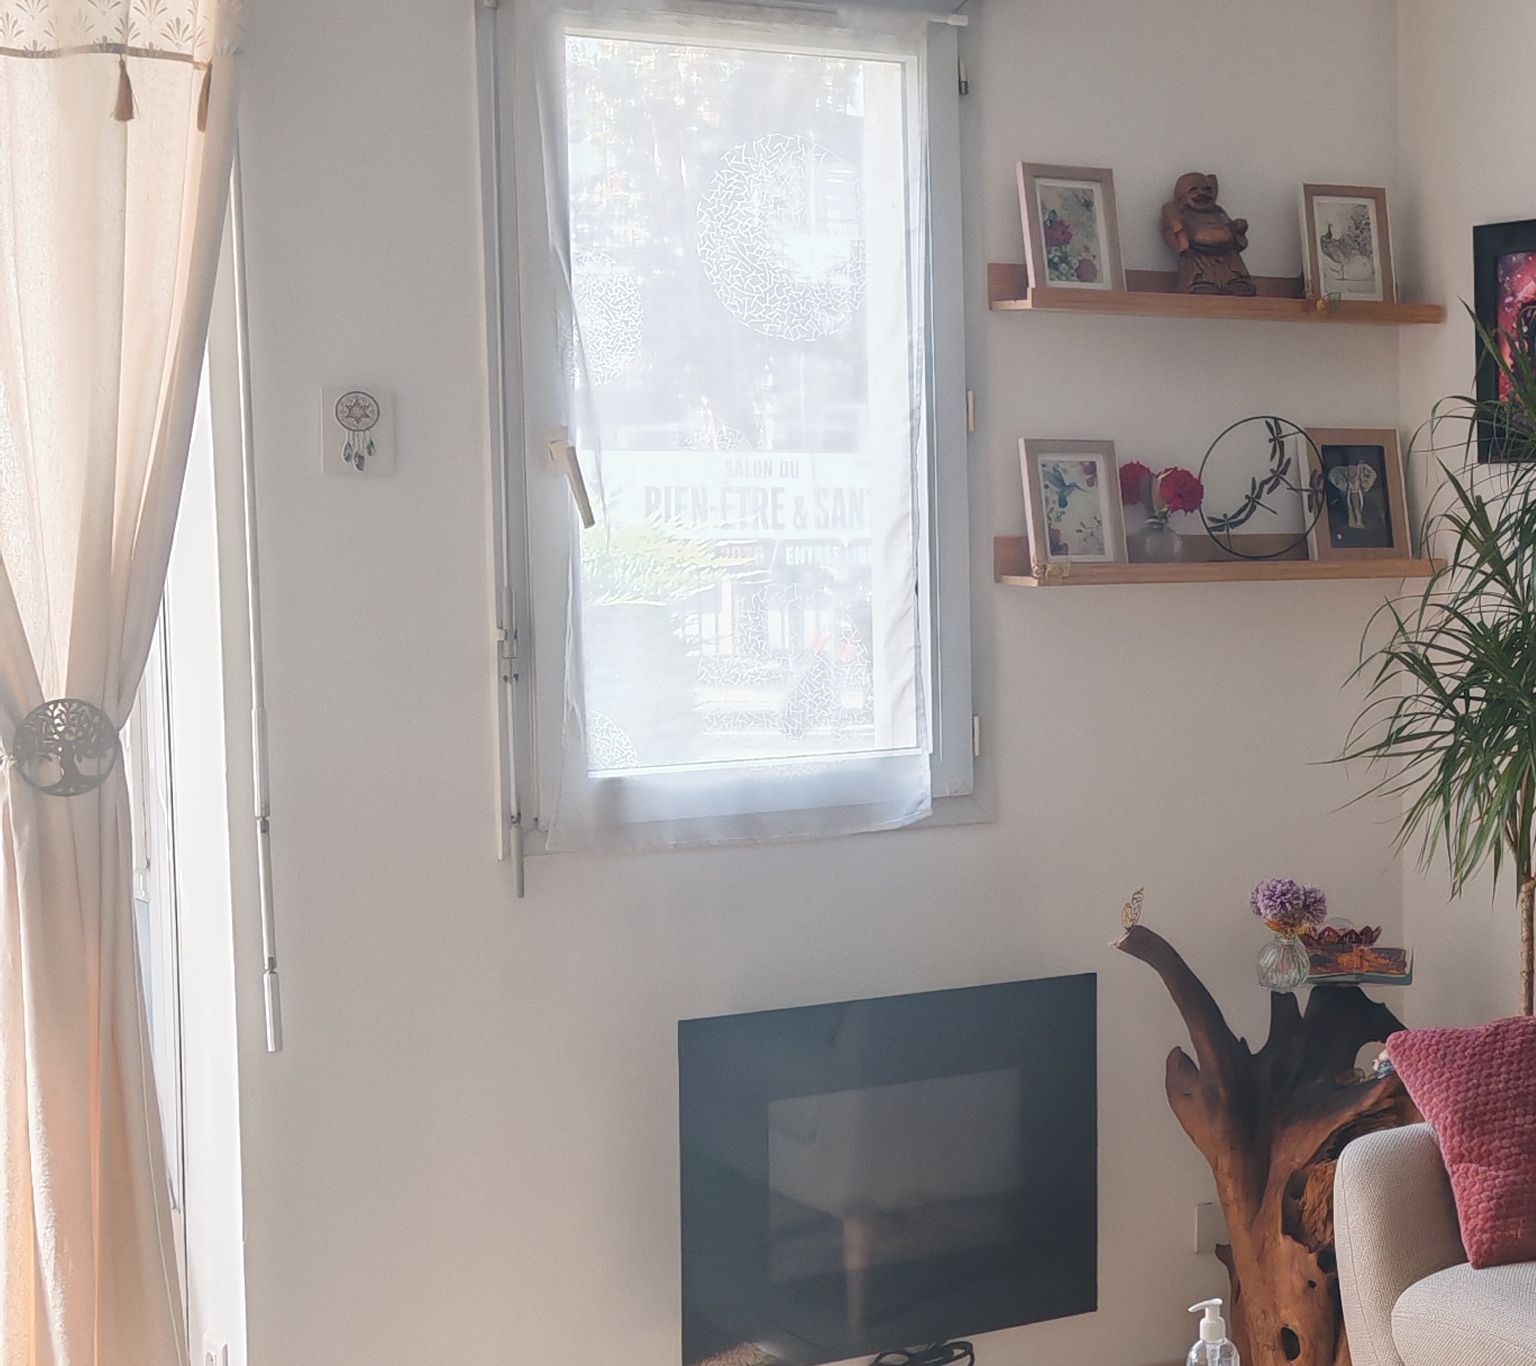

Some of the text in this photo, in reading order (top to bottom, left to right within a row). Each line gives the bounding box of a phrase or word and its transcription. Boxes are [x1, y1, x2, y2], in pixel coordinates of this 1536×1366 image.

[725, 460, 800, 479] SALON DU
[792, 495, 808, 530] &
[814, 487, 871, 530] SAN
